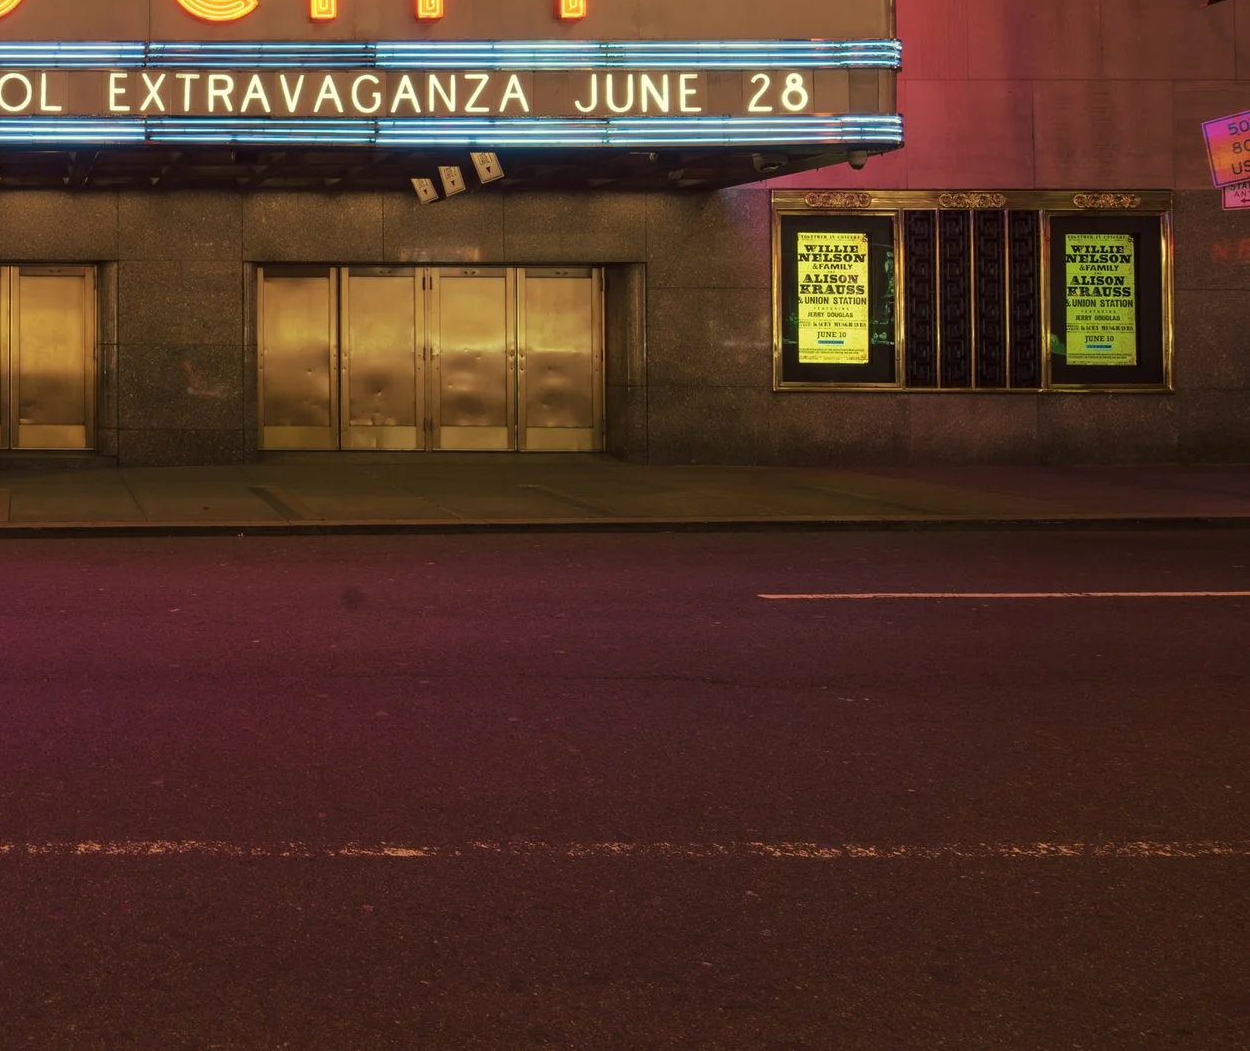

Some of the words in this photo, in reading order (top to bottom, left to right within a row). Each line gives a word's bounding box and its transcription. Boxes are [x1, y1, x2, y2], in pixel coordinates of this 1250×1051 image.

[110, 73, 530, 112] EXTRAVAGANZA
[575, 74, 702, 112] JUNE
[748, 73, 809, 112] 28
[804, 245, 859, 253] WILLIE
[1070, 245, 1125, 254] WILLIE
[798, 253, 866, 263] NELSON
[1065, 254, 1132, 264] NELSON
[803, 274, 859, 284] ALISON
[1070, 276, 1125, 286] ALISON
[799, 284, 865, 295] KRAUSS
[1067, 286, 1131, 297] KRAUSS
[833, 297, 867, 305] STATION
[1072, 299, 1096, 307] UNION
[1100, 300, 1133, 308] STATION
[1085, 335, 1105, 343] JUNE
